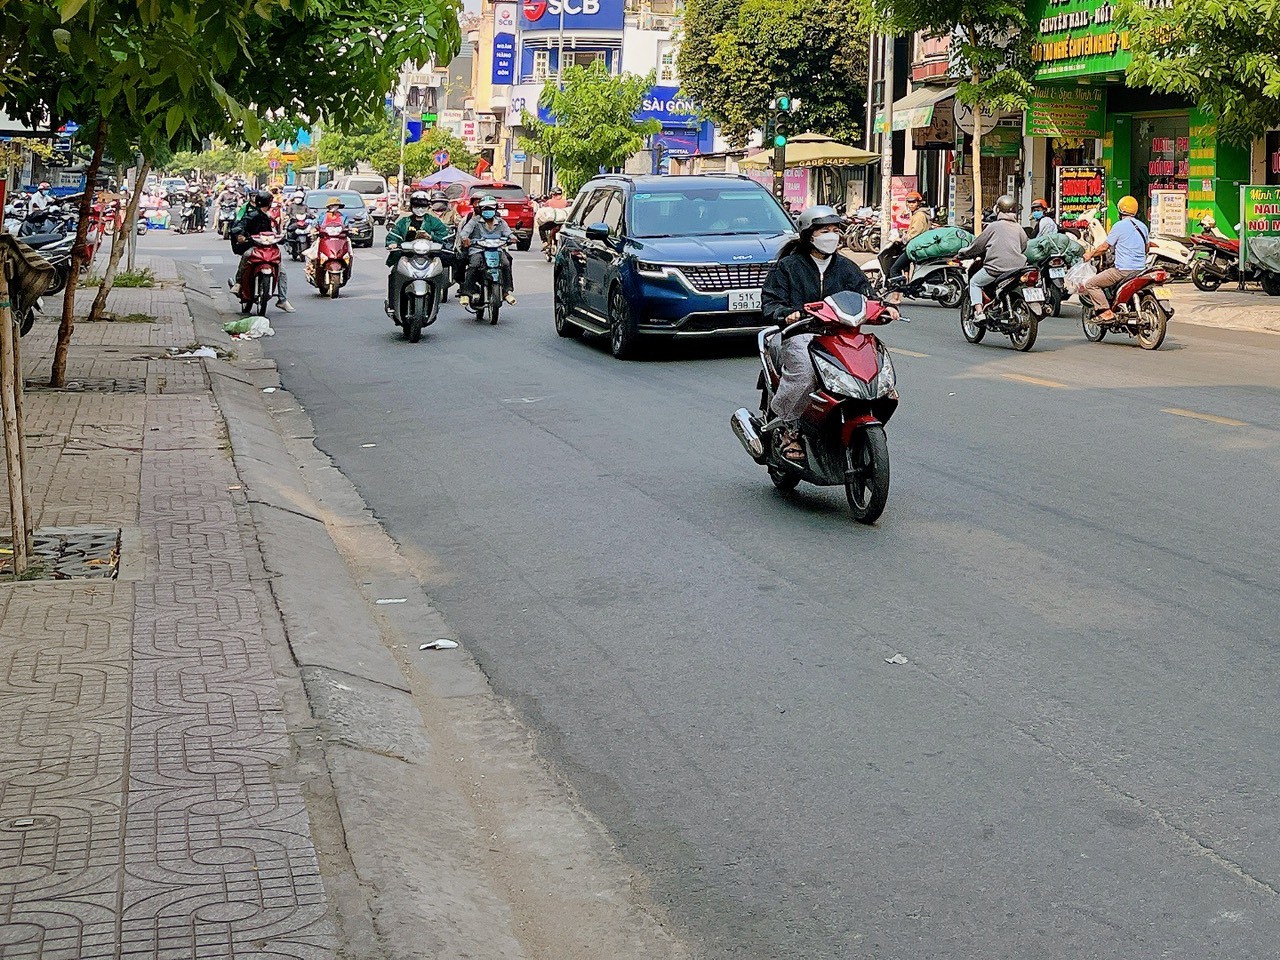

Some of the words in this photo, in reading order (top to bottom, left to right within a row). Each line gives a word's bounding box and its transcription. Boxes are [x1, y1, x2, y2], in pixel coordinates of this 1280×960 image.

[642, 99, 664, 112] SÀI
[1248, 216, 1269, 232] NỐI
[739, 293, 754, 301] 51K
